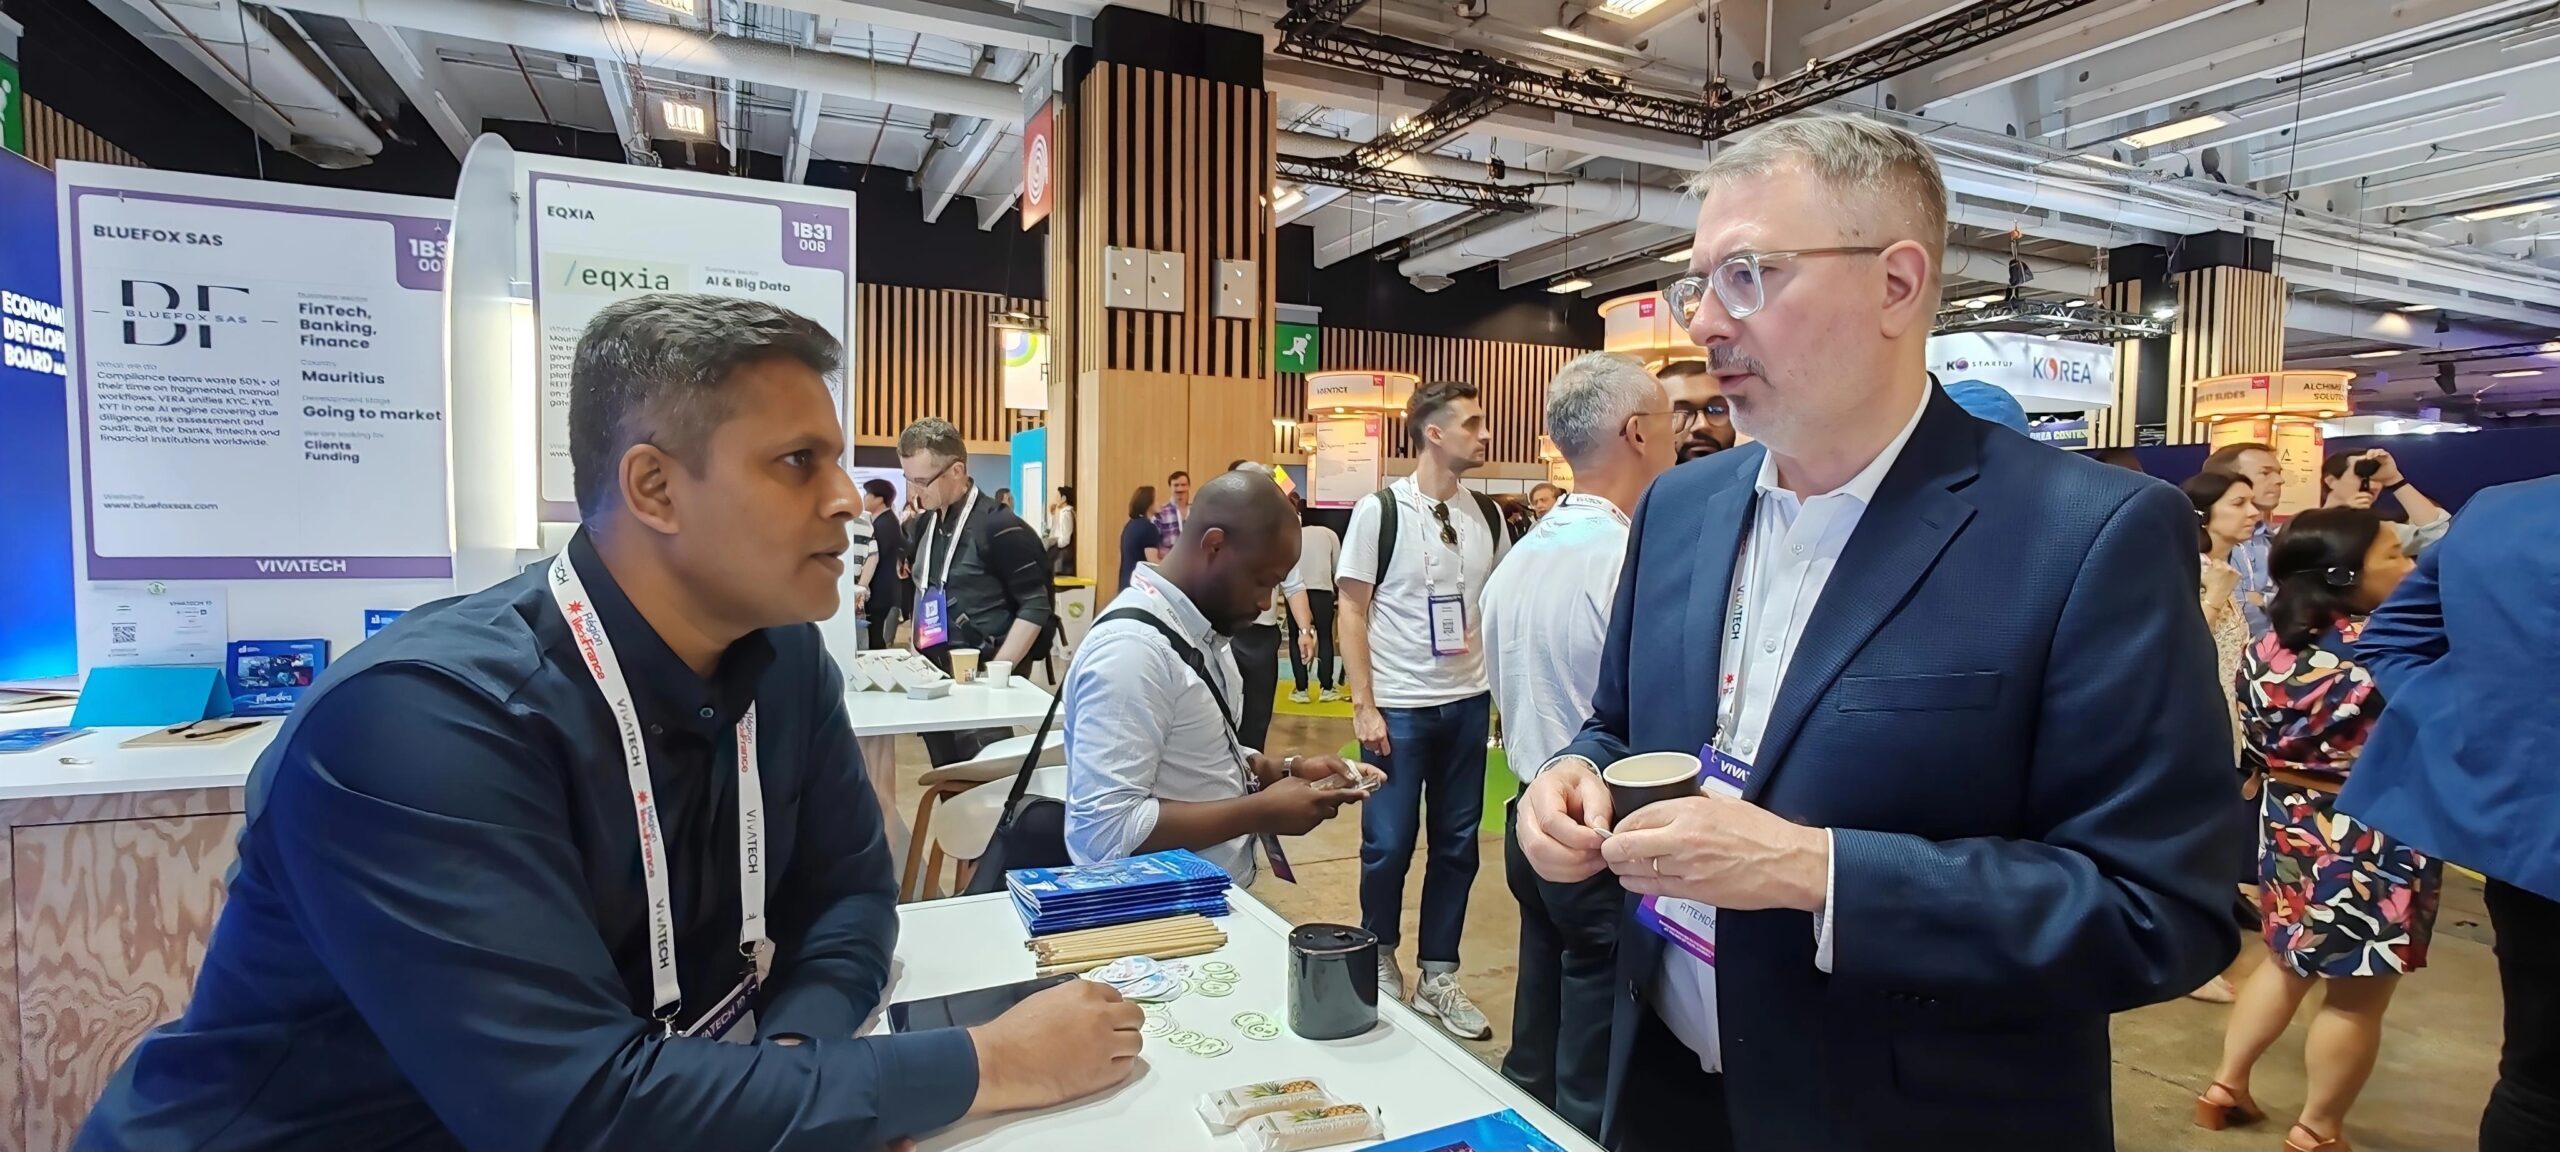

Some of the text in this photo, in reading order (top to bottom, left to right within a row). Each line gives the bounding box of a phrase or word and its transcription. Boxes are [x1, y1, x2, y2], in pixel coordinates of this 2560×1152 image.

[547, 206, 595, 220] EQXIA
[93, 225, 223, 247] BLUEFOX SAS
[792, 221, 832, 240] 1B31
[408, 238, 447, 258] 1B3
[799, 239, 826, 253] 008
[706, 276, 791, 292] AI & Big Data
[126, 309, 249, 324] BLUEFOX SAS
[298, 302, 372, 319] FinTech,
[3, 316, 66, 352] DEVELOP
[300, 334, 370, 349] Finance
[4, 342, 53, 374] BOARD
[97, 371, 165, 382] Compliance
[168, 375, 202, 384] teams
[204, 377, 237, 386] waste
[301, 370, 386, 385] Mauritius
[125, 384, 151, 393] time
[239, 388, 279, 397] manual
[171, 406, 208, 416] engine
[258, 409, 279, 417] due
[302, 405, 443, 422] Going to market
[243, 419, 264, 427] and
[259, 429, 281, 437] and
[304, 440, 352, 450] Clients
[305, 451, 360, 464] Funding
[256, 559, 347, 573] VIVATECH
[1730, 584, 1746, 641] VIVATECH
[616, 698, 642, 767] VIVATECH
[1721, 760, 1749, 782] VIVA
[745, 808, 759, 874] VIVATECH
[1680, 902, 1716, 930] ATTENDE
[655, 897, 670, 970] VIVATECH
